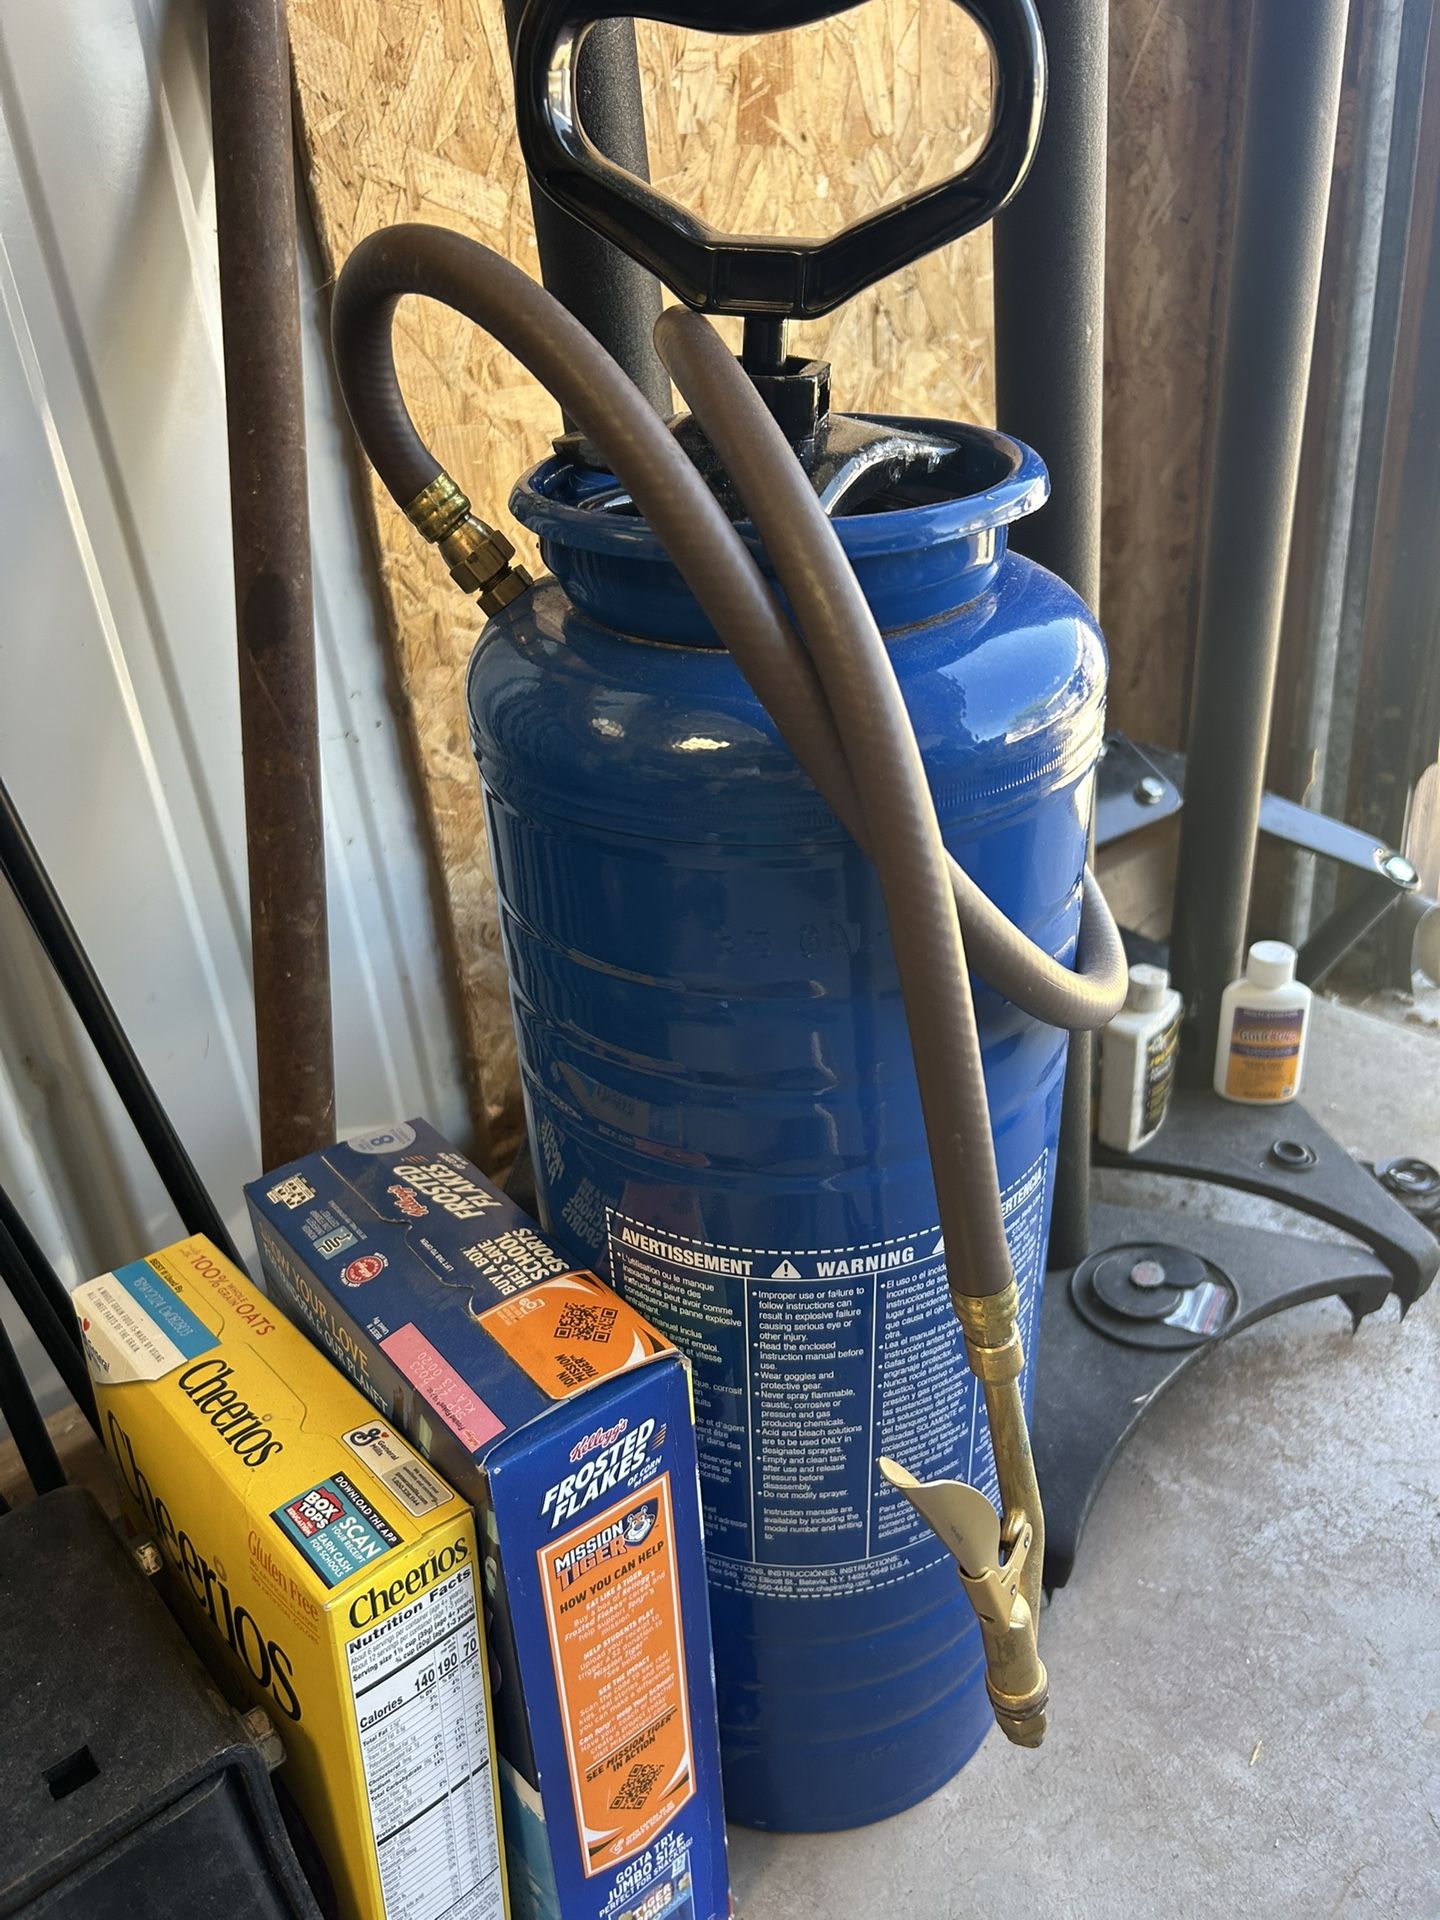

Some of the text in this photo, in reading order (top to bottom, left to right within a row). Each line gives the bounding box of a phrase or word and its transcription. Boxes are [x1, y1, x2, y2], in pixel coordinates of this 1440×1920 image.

[370, 1135, 394, 1146] 8
[393, 1165, 486, 1219] FROSTED
[420, 1163, 503, 1208] FLAKES
[1001, 1167, 1042, 1216] ERTENCIA
[477, 1239, 532, 1288] HELP SAVE
[494, 1232, 549, 1281] SCHOOL
[512, 1228, 569, 1272] SPORTS
[622, 1227, 753, 1276] AVERTISSEMENT
[816, 1246, 914, 1277] WARNING
[191, 1255, 226, 1288] 100%
[463, 1247, 517, 1295] BUY A BOX
[683, 1278, 714, 1291] manque
[886, 1271, 926, 1289] El uso el
[217, 1287, 238, 1306] GRAIN
[227, 1281, 248, 1302] WHOLE
[663, 1281, 685, 1295] suivre
[759, 1291, 796, 1300] Improper
[828, 1289, 854, 1298] failure
[886, 1284, 924, 1299] incorrecto
[886, 1289, 934, 1309] instrucciones
[664, 1293, 733, 1315] peut avoir comme
[680, 1308, 742, 1327] panne explosive
[786, 1301, 834, 1309] instructions
[795, 1311, 833, 1320] explosive
[836, 1309, 861, 1318] failure
[885, 1305, 944, 1330] que causa ojo
[886, 1293, 947, 1319] lugar al incidente
[236, 1304, 275, 1336] OATS
[293, 1271, 329, 1326] YOUR
[331, 1316, 370, 1377] LOVE
[760, 1322, 791, 1331] causing
[794, 1322, 824, 1330] serious
[827, 1322, 841, 1330] eye
[760, 1332, 808, 1342] other injury.
[760, 1341, 836, 1350] Read the enclosed
[885, 1327, 936, 1350] Lea manual
[555, 1354, 590, 1382] MISSION
[575, 1358, 598, 1378] TIGER
[760, 1348, 864, 1360] instruction manual before
[346, 1358, 388, 1413] PLANET
[408, 1359, 467, 1420] SEP 22 2023
[441, 1376, 457, 1392] 13
[556, 1371, 577, 1388] JOIN
[713, 1384, 742, 1395] corrosif
[760, 1371, 782, 1379] Wear
[784, 1371, 816, 1381] goggles
[761, 1381, 800, 1390] protective
[884, 1377, 907, 1388] Nunca
[761, 1391, 808, 1400] Never spray
[794, 1400, 830, 1409] corrosive
[178, 1359, 283, 1467] Cheerios
[761, 1410, 830, 1419] pressure and gas
[762, 1420, 801, 1428] producing
[570, 1418, 628, 1462] Kellogg's
[762, 1428, 796, 1436] Acid and
[370, 1443, 383, 1456] Mills
[378, 1441, 399, 1461] General
[541, 1418, 655, 1515] FROSTED
[640, 1456, 662, 1477] CORN
[551, 1442, 647, 1529] FLAKES
[299, 1502, 328, 1529] TOPS
[304, 1491, 339, 1518] BOX
[335, 1476, 397, 1542] DOWNLOAD THE APP
[286, 1508, 312, 1536] EDUCATION
[339, 1517, 381, 1558] SCAN
[310, 1539, 344, 1577] FOR SCHOOLS
[317, 1533, 353, 1572] EARN CASH
[332, 1526, 366, 1563] YOUR RECEIPT
[555, 1520, 624, 1574] MISSION
[108, 1409, 302, 1722] Cheerios
[248, 1531, 287, 1591] Gluten
[290, 1579, 318, 1622] Free
[556, 1535, 627, 1592] TIGER
[560, 1541, 664, 1614] HOW YOU CAN HELP
[350, 1537, 468, 1629] Cheerios
[586, 1570, 642, 1611] EAT LIKE TIGER
[349, 1569, 470, 1654] Nutrition Facts
[603, 1608, 654, 1647] STUDENTS PLAY
[353, 1638, 417, 1681] Serving size cup
[415, 1638, 477, 1691] 140 190 70
[360, 1696, 403, 1728] Calories
[586, 1714, 672, 1782] SEE MISSION TIGER
[613, 1735, 656, 1772] IN ACTION
[608, 1862, 652, 1904] JUMBO
[656, 1833, 684, 1865] SIZE
[616, 1851, 652, 1884] GOTTA
[654, 1830, 674, 1853] TRY
[599, 1887, 635, 1918] PERFECT
[637, 1874, 652, 1890] FOR
[653, 1837, 693, 1876] SNACKING!
[632, 1883, 672, 1918] TIGER
